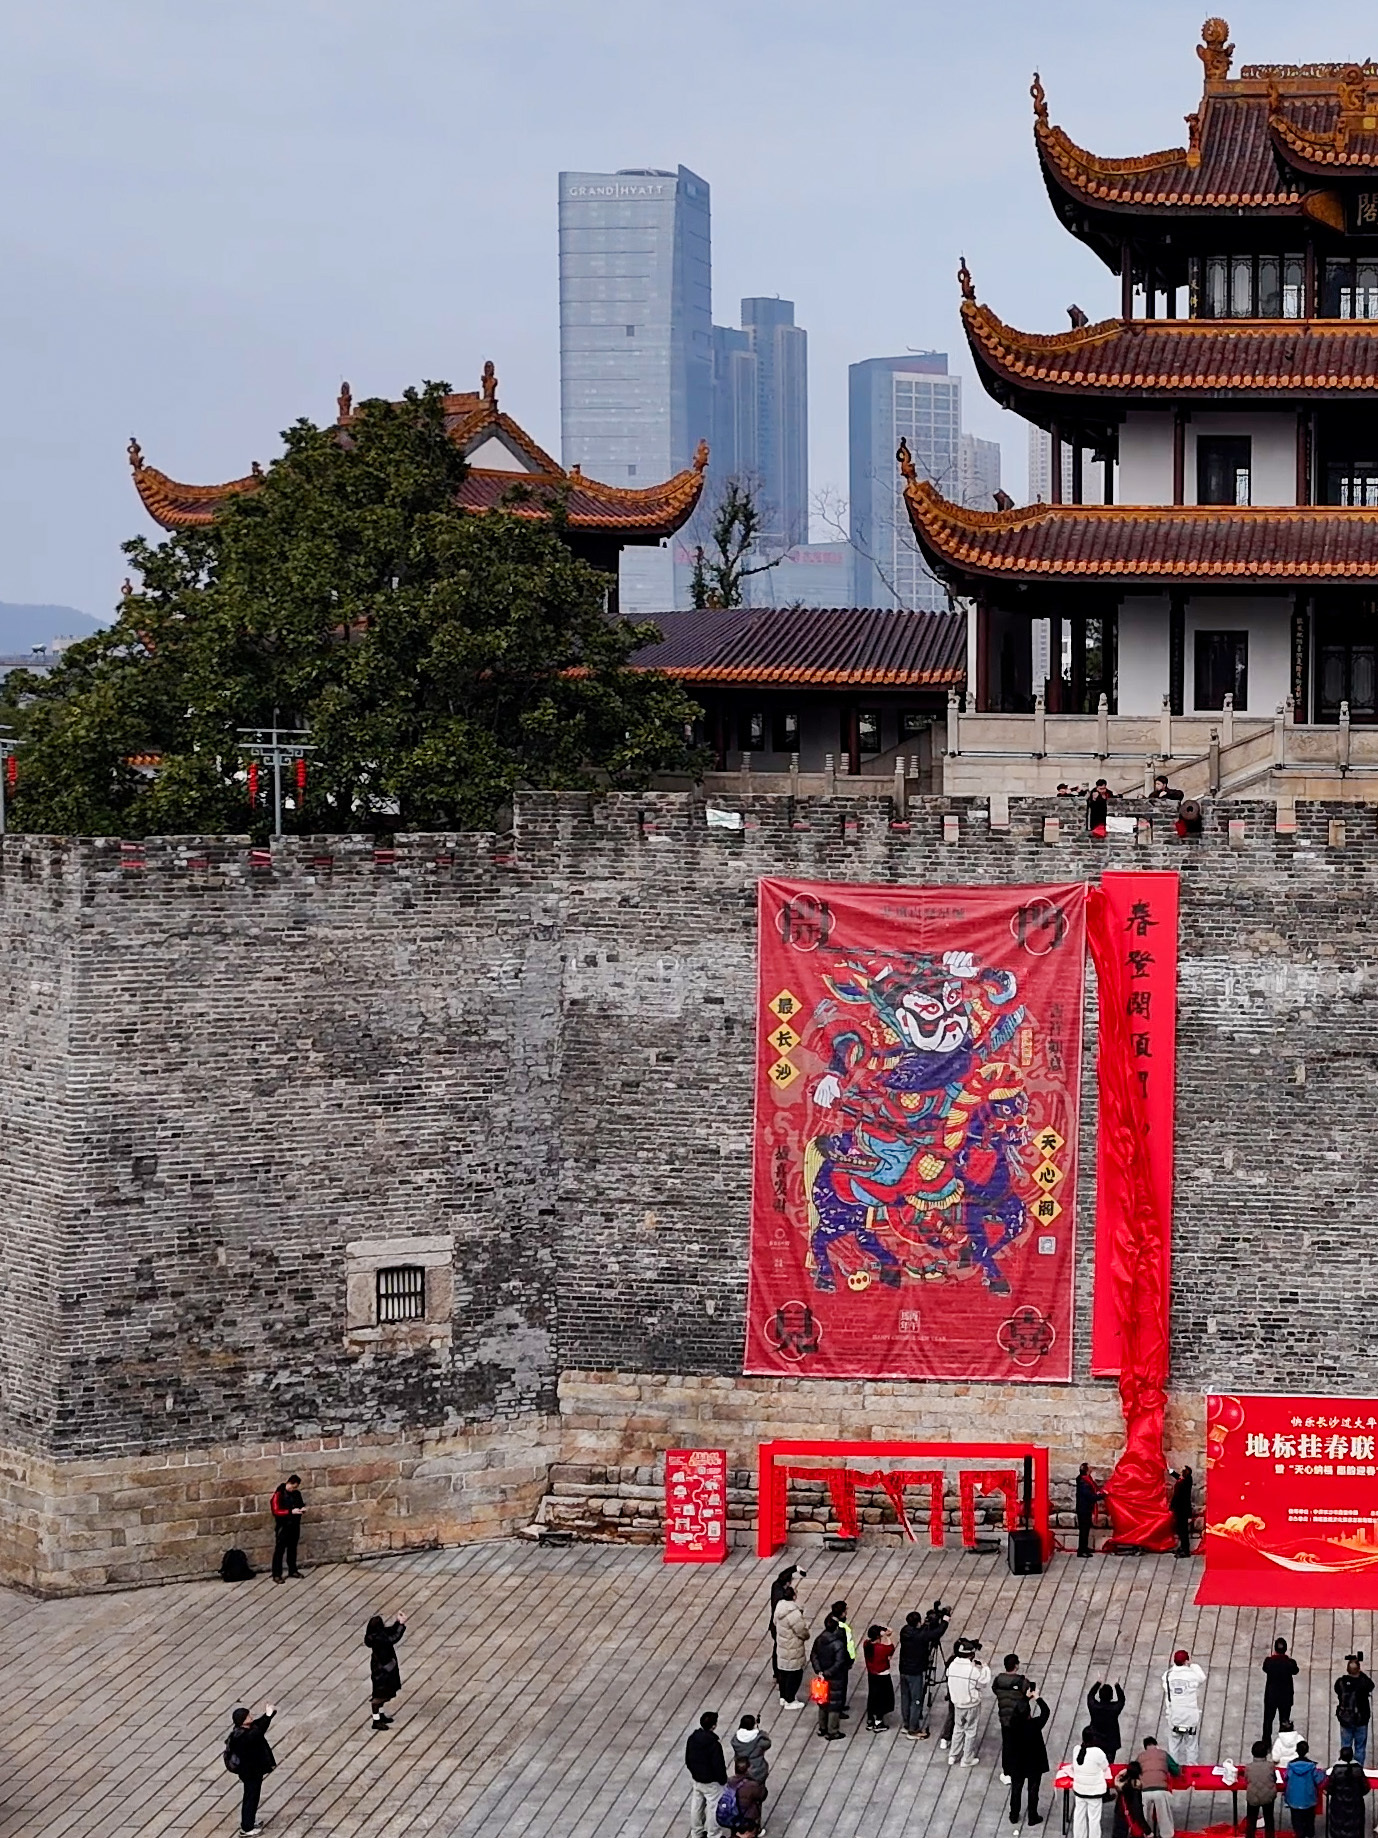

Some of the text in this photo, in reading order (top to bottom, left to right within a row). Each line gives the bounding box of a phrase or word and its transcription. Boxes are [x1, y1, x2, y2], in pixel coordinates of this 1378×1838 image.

[569, 185, 663, 196] GRAND HYATT
[775, 997, 794, 1081] 最长沙
[1038, 1134, 1056, 1217] 天心阁
[1290, 1416, 1377, 1430] 快乐长沙过大年
[1245, 1432, 1375, 1461] 地标挂春联
